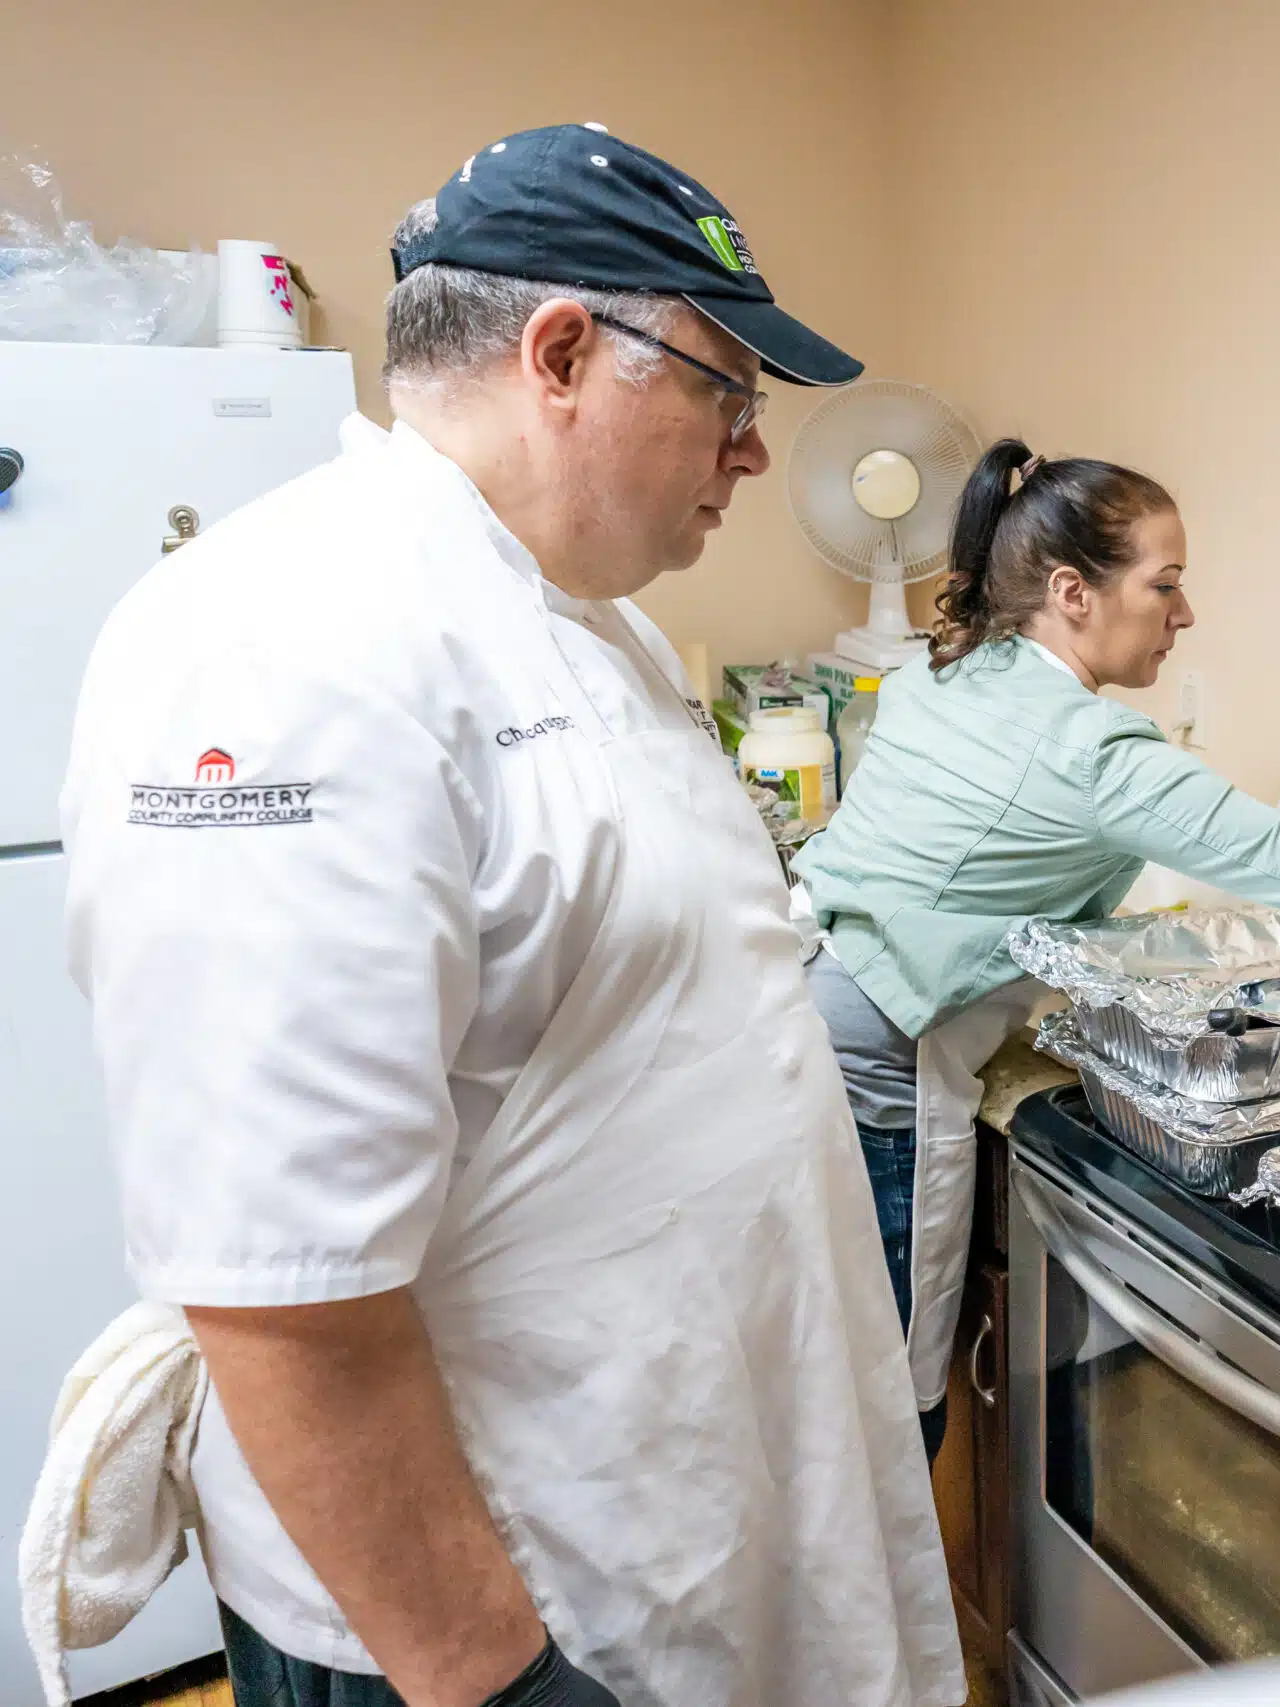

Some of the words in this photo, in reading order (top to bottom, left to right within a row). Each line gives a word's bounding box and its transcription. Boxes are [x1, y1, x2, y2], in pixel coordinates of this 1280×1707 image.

[131, 788, 312, 809] MONTGOMERY
[128, 809, 173, 822] COUNTY
[175, 811, 254, 823] COMMUNITY
[256, 808, 313, 821] COLLEGE
